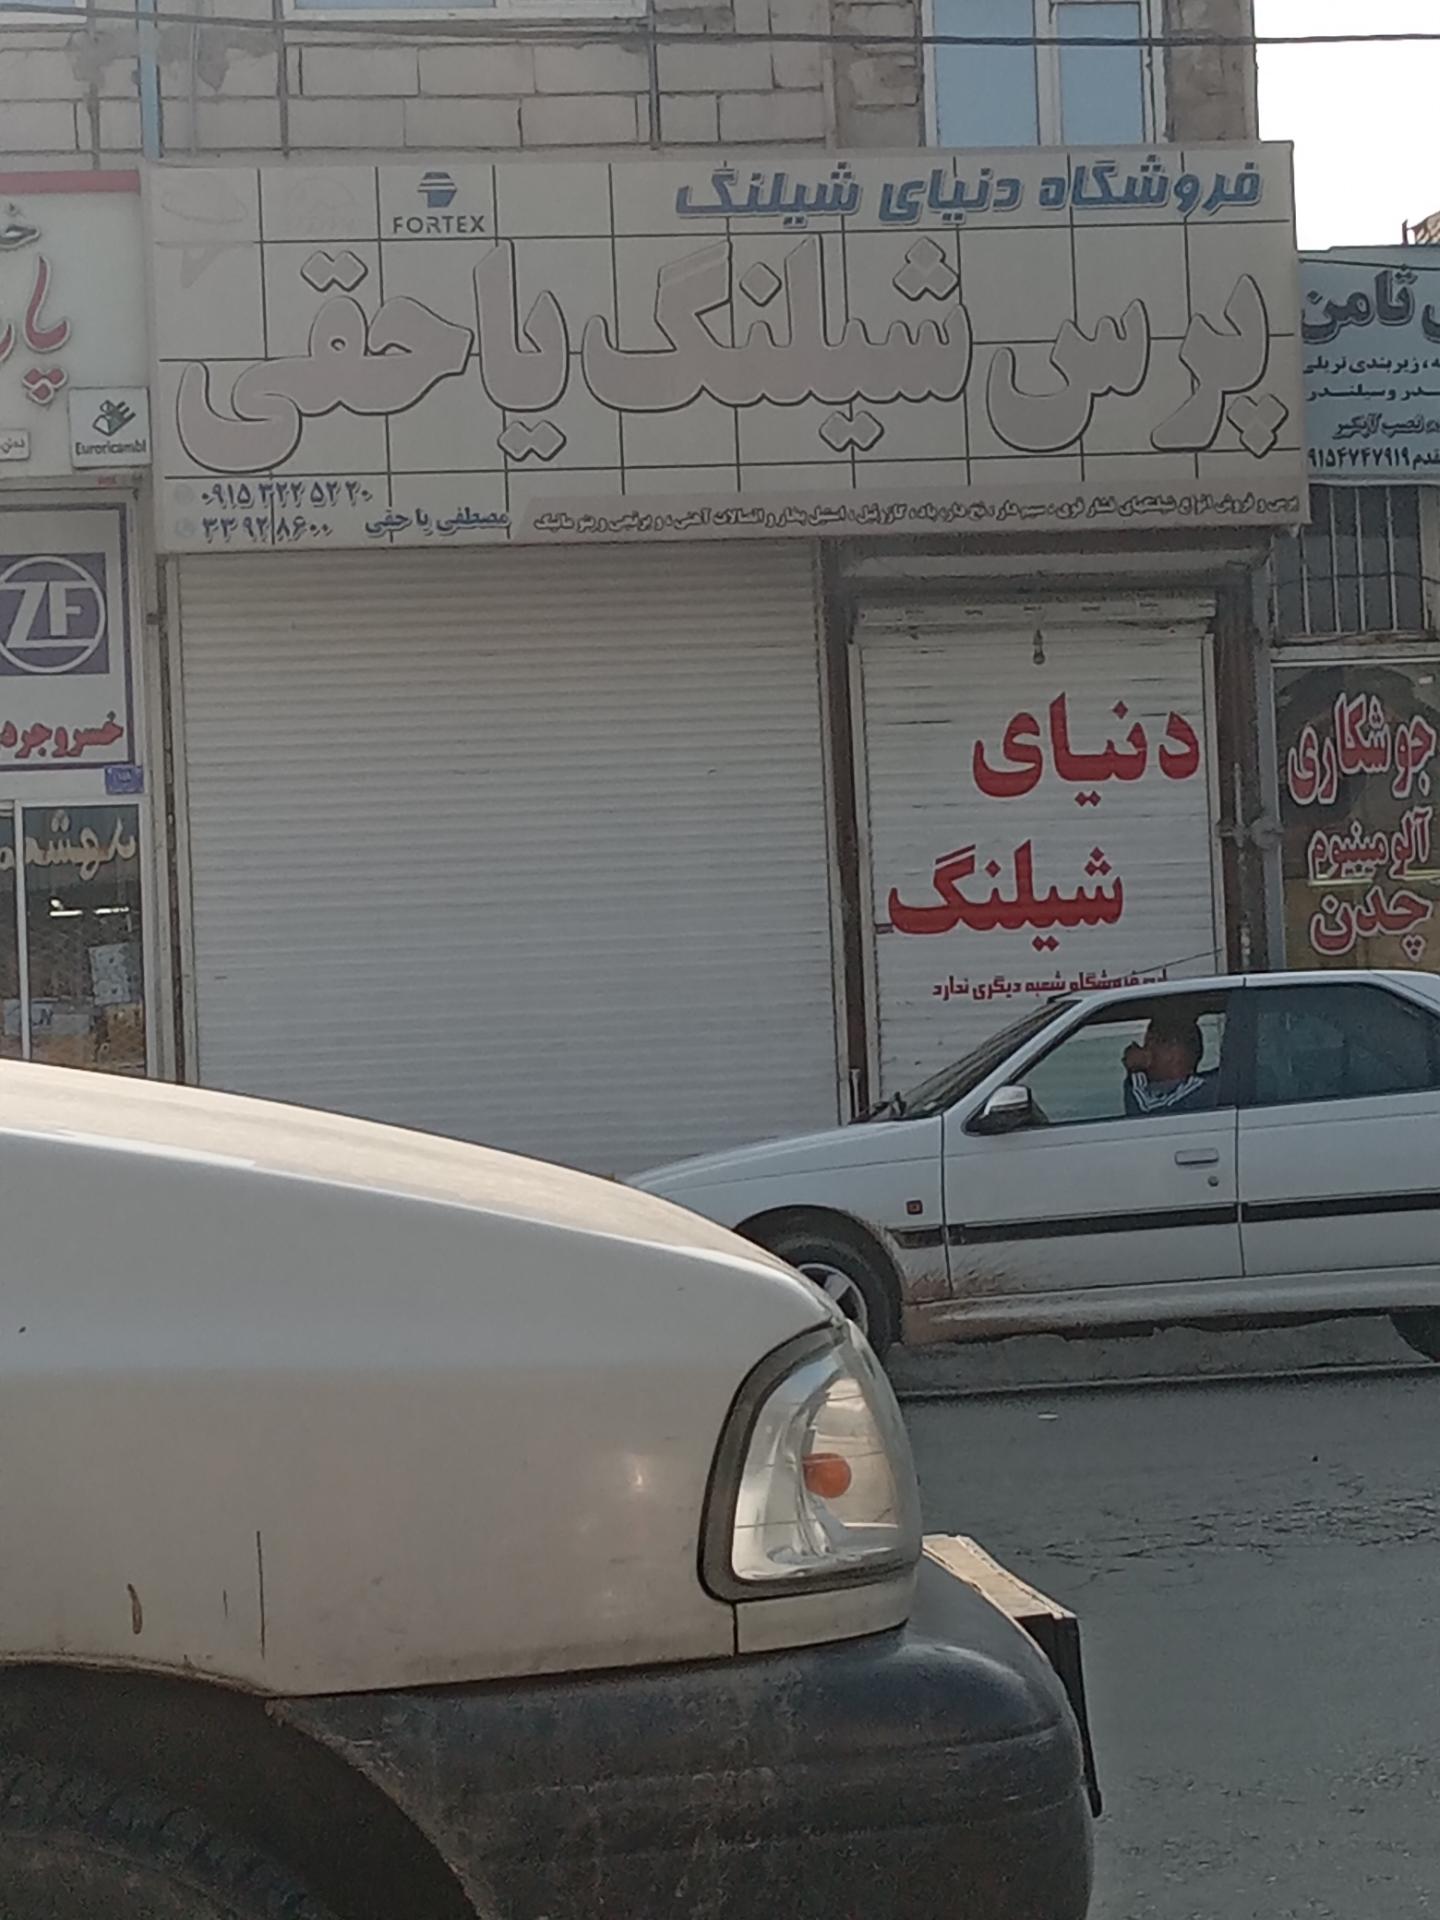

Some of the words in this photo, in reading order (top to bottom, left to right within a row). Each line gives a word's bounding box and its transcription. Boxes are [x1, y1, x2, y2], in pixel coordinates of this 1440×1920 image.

[675, 162, 862, 228] شیلنگ
[879, 167, 1023, 226] دنیای
[1039, 154, 1264, 218] فروشگاه
[393, 215, 487, 235] FORTEX
[579, 230, 974, 453] شیلنگ
[986, 272, 1290, 459] پرس
[436, 506, 512, 536] مصطفی
[0, 581, 97, 649] ZF
[972, 691, 1200, 807] دنیای
[1288, 692, 1437, 805] جوشکاری
[887, 840, 1125, 952] شیلنگ
[1310, 885, 1433, 962] چدن
[932, 975, 969, 1001] ندارد
[972, 974, 1022, 1000] دیگری
[1025, 970, 1066, 997] شعبه
